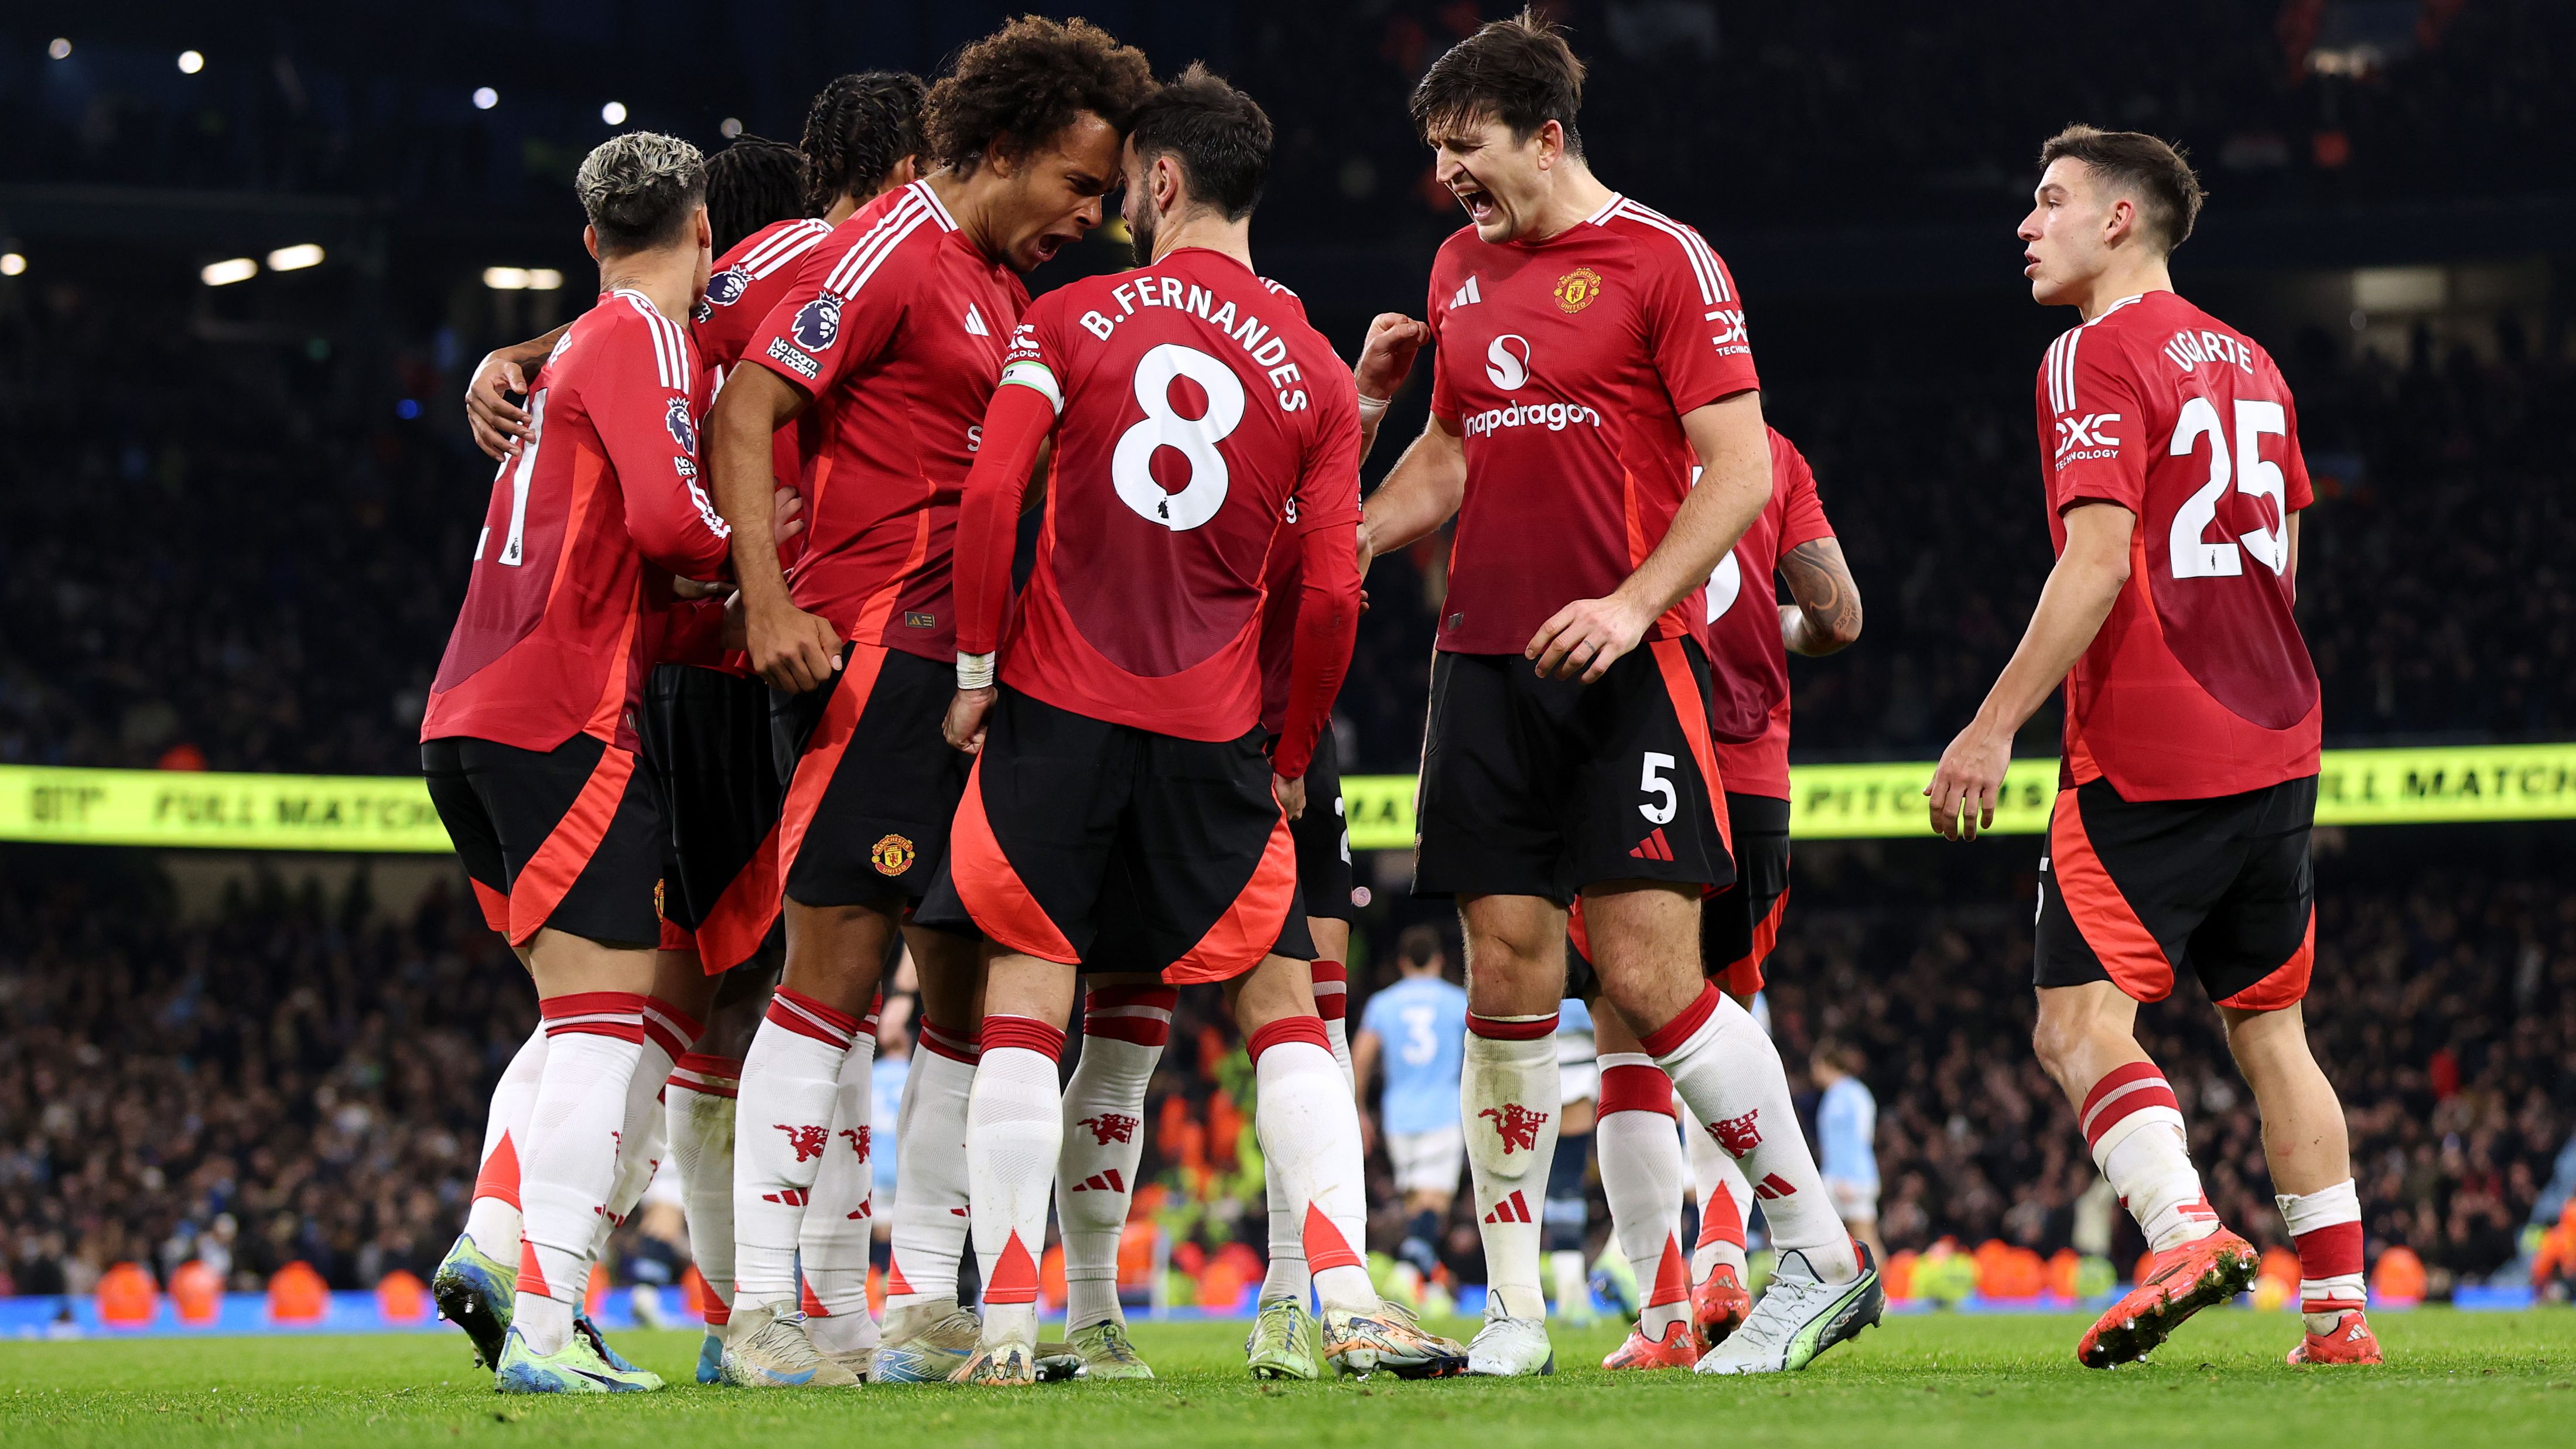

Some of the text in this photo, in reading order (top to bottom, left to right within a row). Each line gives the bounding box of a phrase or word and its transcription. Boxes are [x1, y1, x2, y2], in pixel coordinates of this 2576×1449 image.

[1560, 302, 1586, 310] UNITED
[1079, 276, 1307, 412] B.FERNANDES
[1704, 309, 1749, 345] DX
[766, 347, 816, 380] for racism
[771, 336, 818, 370] No room
[1716, 345, 1751, 357] TECHNO
[1112, 343, 1246, 531] 8
[2055, 449, 2119, 472] TECHNOLOGY
[2168, 396, 2290, 580] 25
[1638, 751, 1677, 824] 5
[876, 837, 910, 853] MANCHESTER
[883, 865, 907, 874] UNITED
[1401, 1006, 1438, 1065] 3
